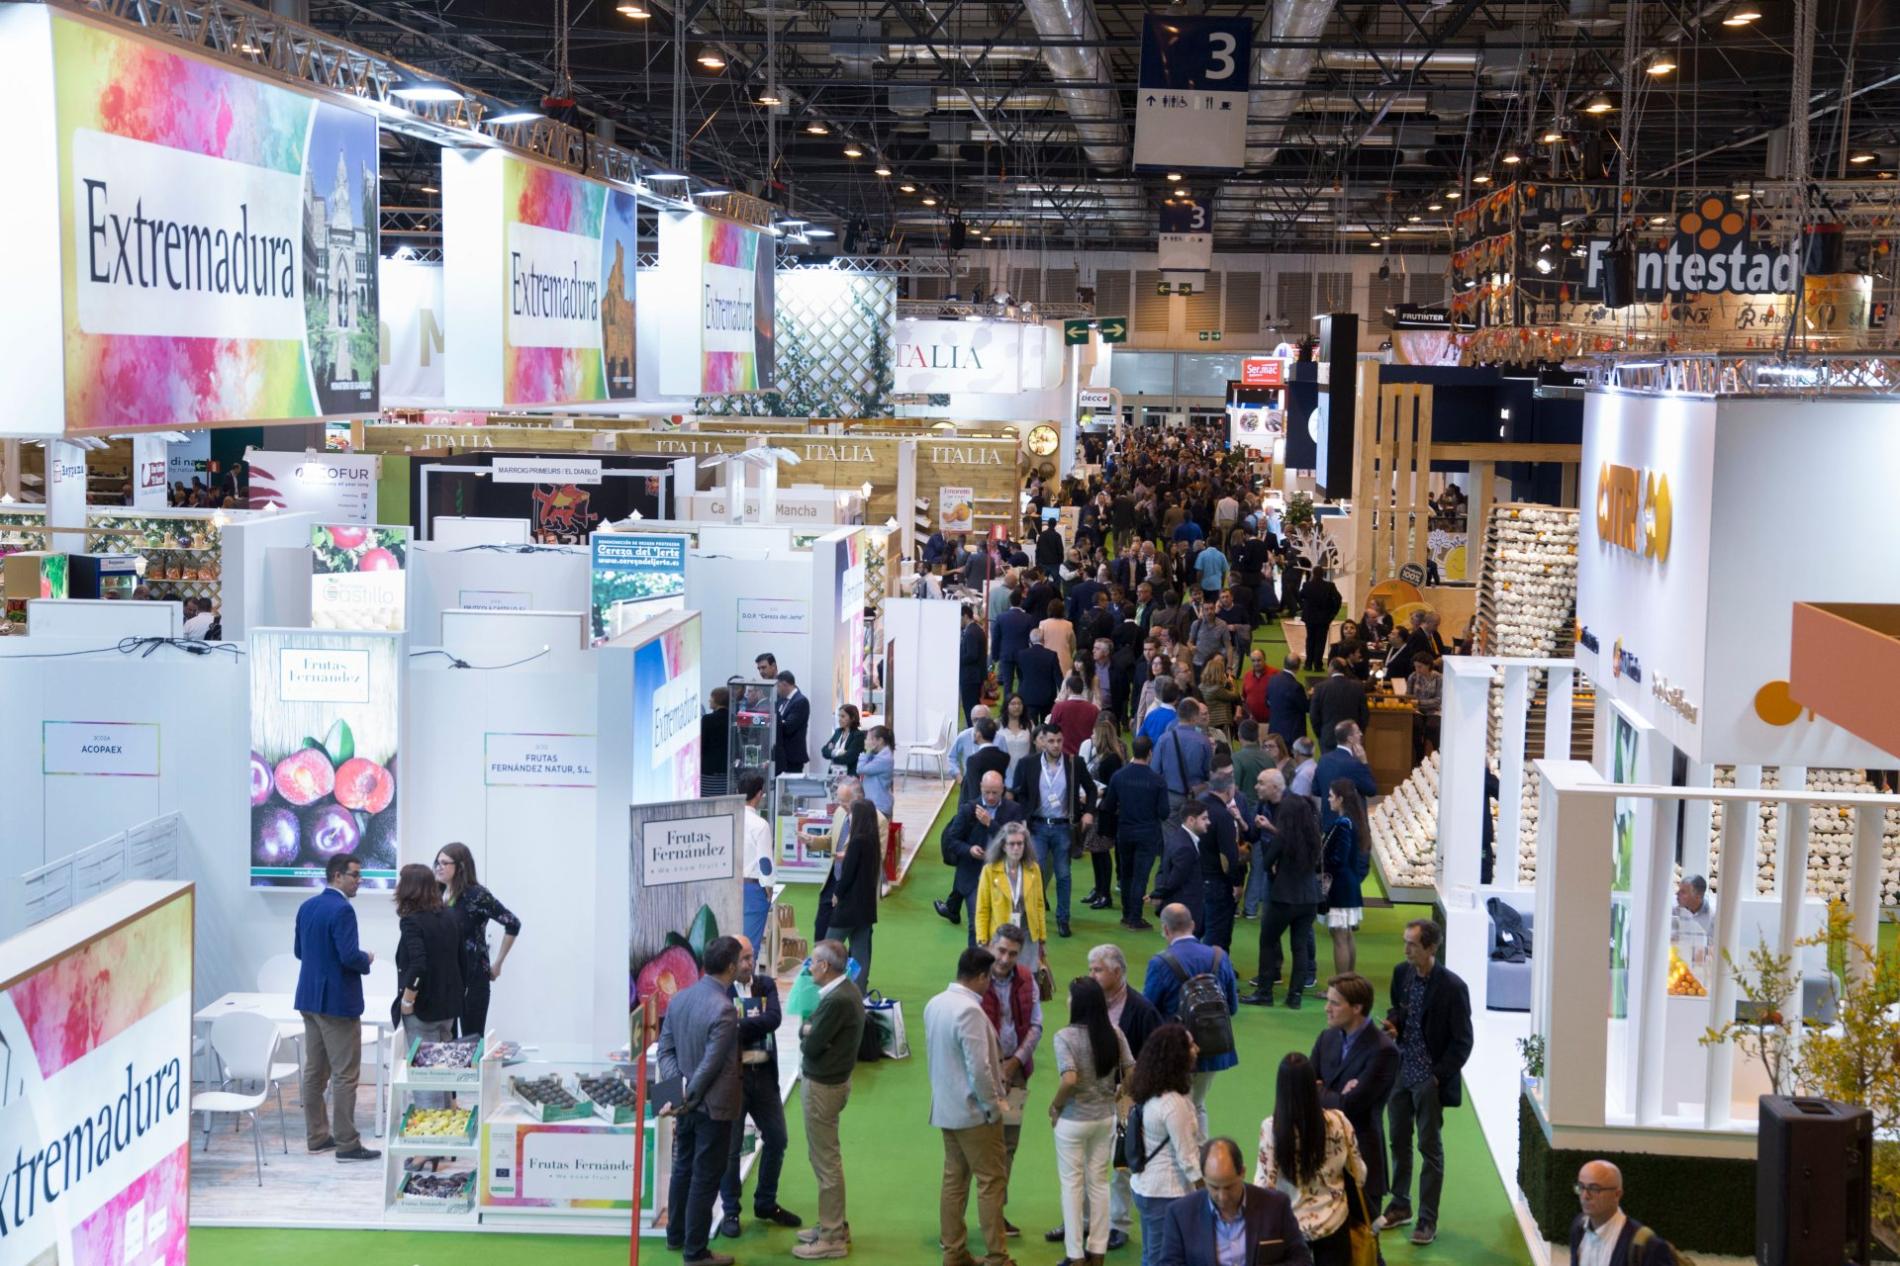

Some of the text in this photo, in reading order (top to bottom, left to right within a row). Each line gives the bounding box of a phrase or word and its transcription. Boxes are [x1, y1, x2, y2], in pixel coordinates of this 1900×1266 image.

[1205, 32, 1237, 80] 3
[1190, 206, 1205, 228] 3
[83, 178, 294, 299] Extremadura
[1588, 239, 1799, 293] Fntestad
[512, 251, 597, 321] Extremadura
[705, 283, 753, 332] Extremadura
[1402, 312, 1443, 321] FRUTINTER
[805, 444, 875, 462] ITALIA
[932, 446, 1002, 465] ITALIA
[775, 504, 817, 517] Mancha
[598, 545, 632, 557] Cereza
[636, 547, 651, 556] del
[654, 687, 698, 748] Extremadura
[81, 745, 122, 753] ACOPAEX
[525, 754, 558, 763] FRUTAS
[491, 763, 592, 775] FERNÁNDEZ NATUR, S.L.
[667, 830, 711, 846] Frutas
[529, 1157, 569, 1169] Frutas
[575, 1158, 634, 1171] Fernánde
